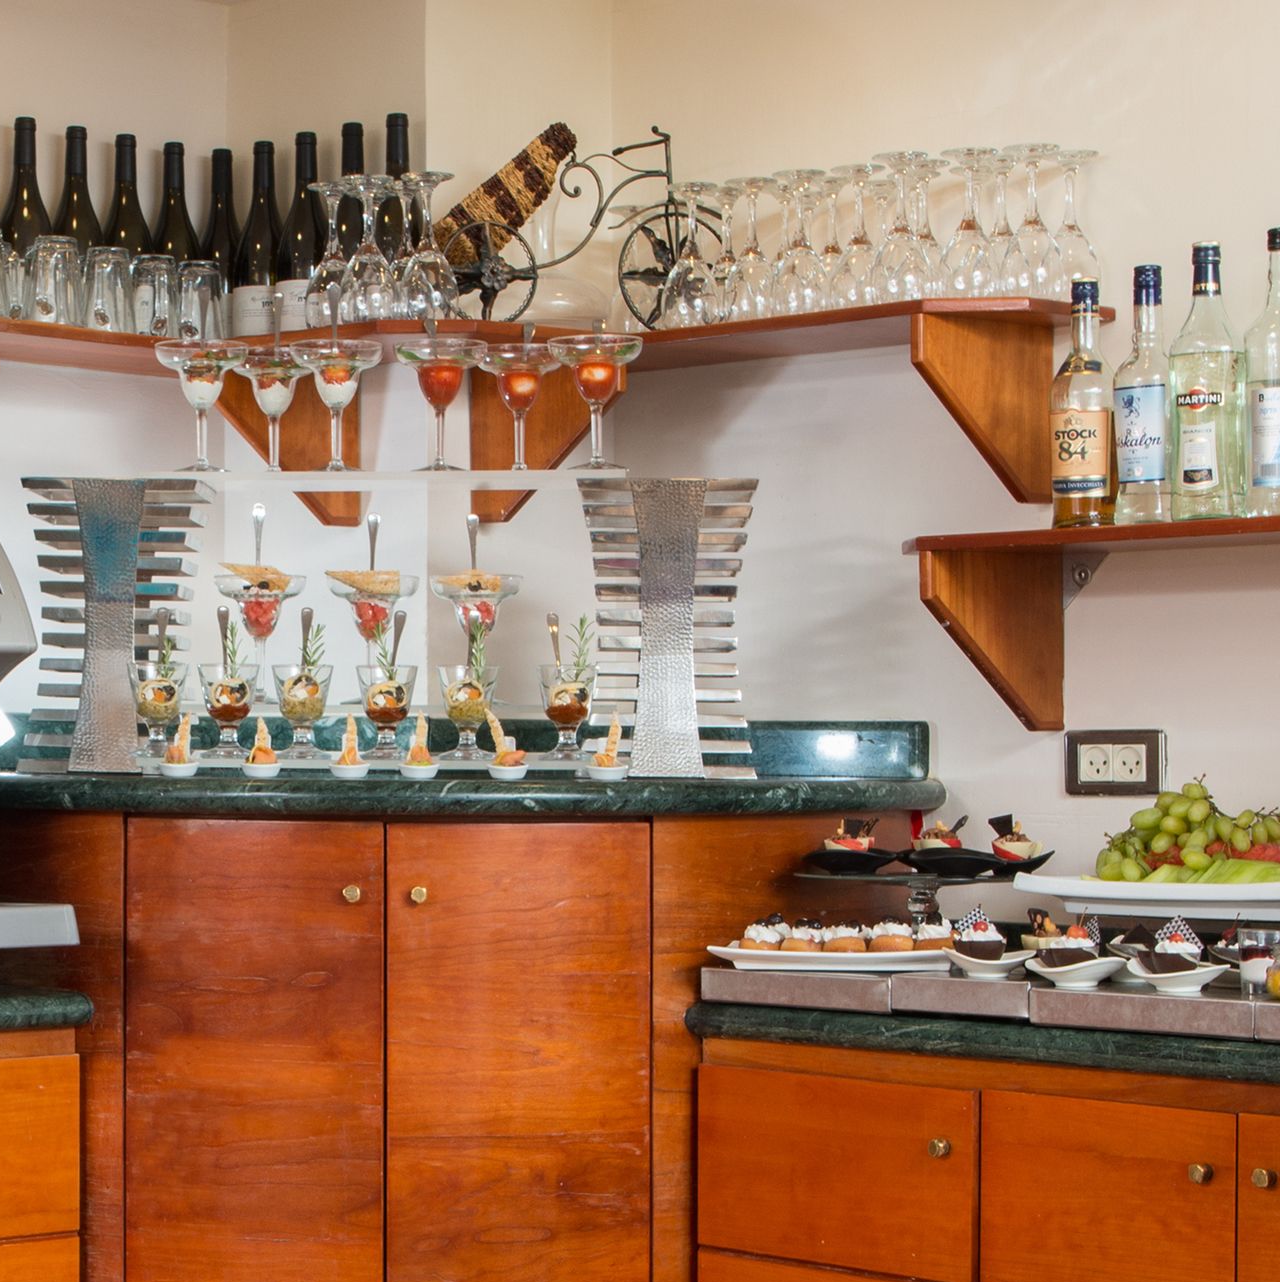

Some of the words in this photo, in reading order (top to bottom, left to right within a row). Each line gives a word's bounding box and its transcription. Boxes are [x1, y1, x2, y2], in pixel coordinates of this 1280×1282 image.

[1178, 394, 1222, 405] MARTINI
[1055, 429, 1097, 441] STOCK
[1058, 440, 1088, 462] 84
